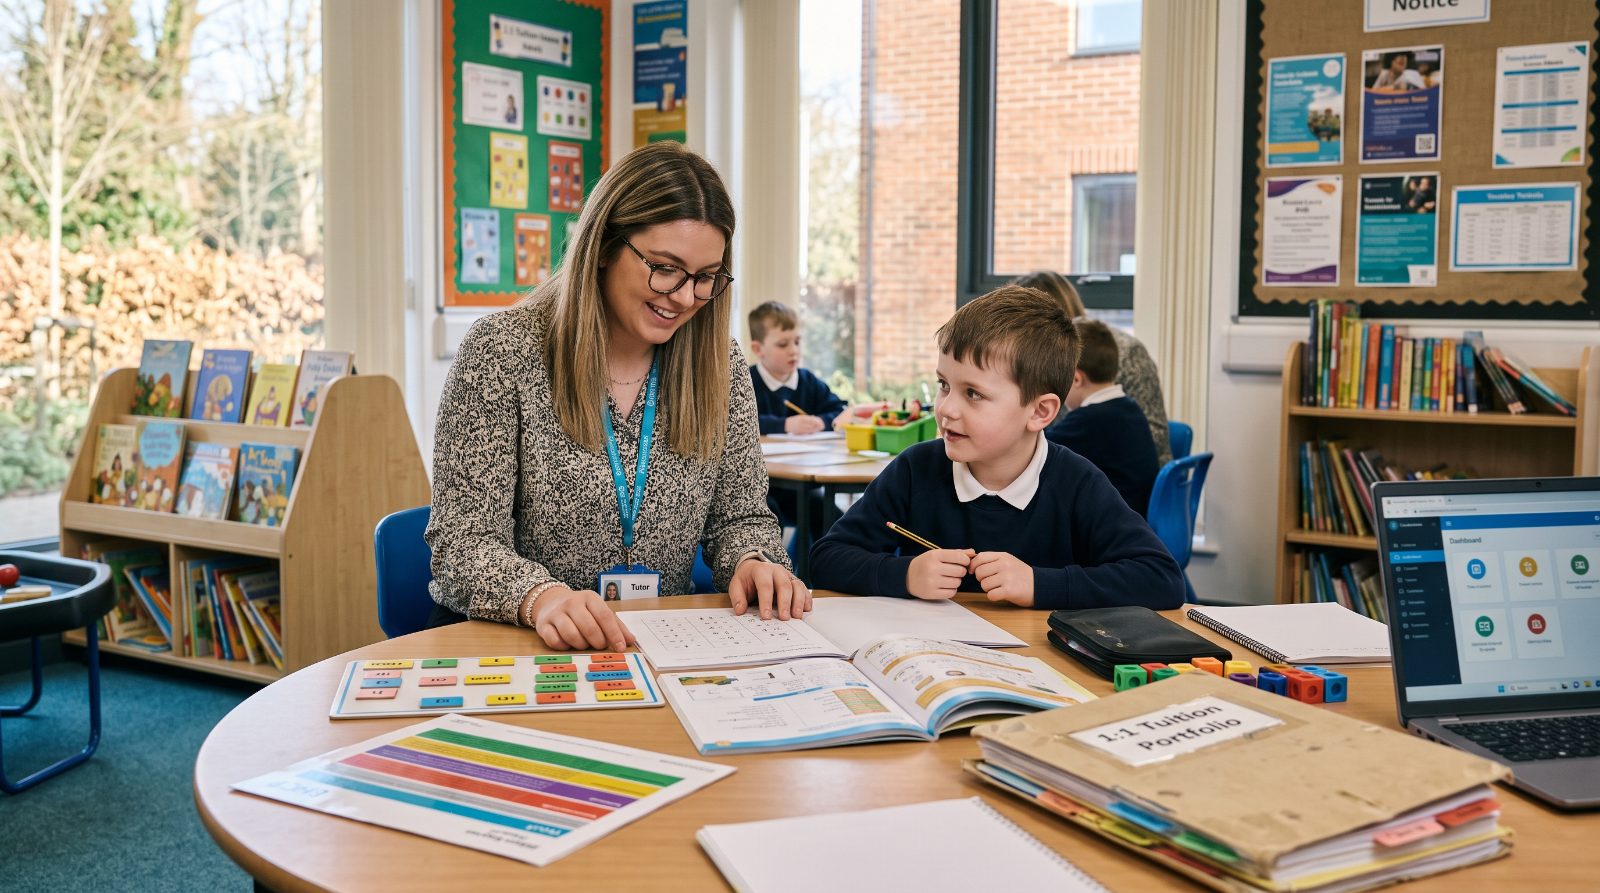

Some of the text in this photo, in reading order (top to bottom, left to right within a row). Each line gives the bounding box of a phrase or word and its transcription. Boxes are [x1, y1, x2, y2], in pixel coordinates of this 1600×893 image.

[1393, 0, 1459, 12] Notice
[1449, 537, 1482, 545] Dashboard
[631, 583, 650, 591] Tutor
[1097, 705, 1223, 743] 1:1 Tuition
[1137, 718, 1242, 751] Portfolio
